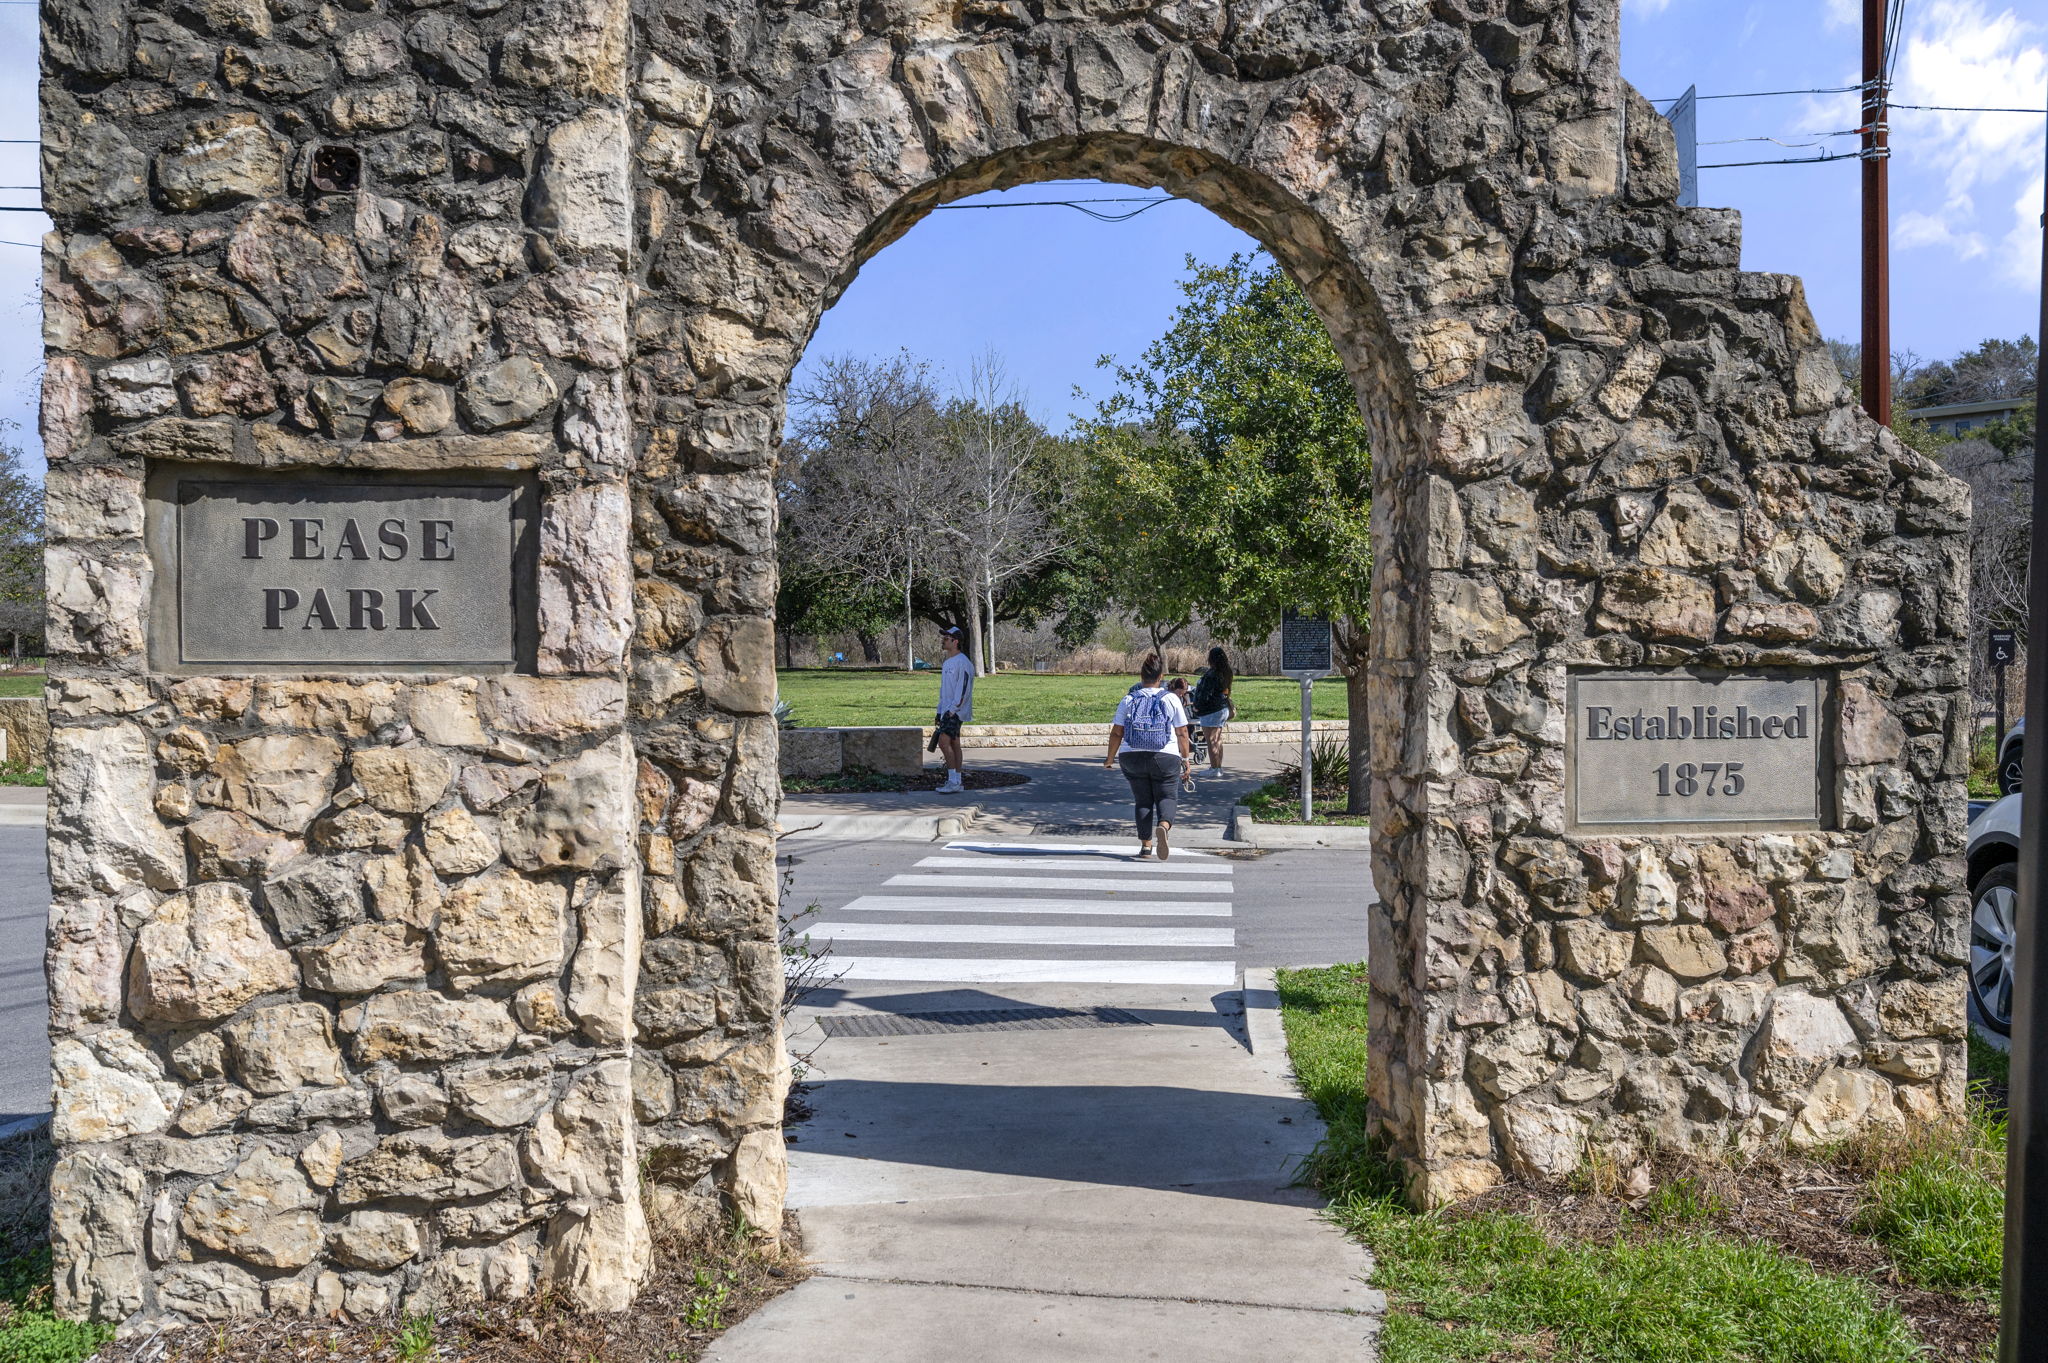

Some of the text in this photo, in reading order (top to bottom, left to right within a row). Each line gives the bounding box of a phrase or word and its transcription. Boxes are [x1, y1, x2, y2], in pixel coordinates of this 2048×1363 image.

[241, 517, 456, 562] PEASE
[262, 587, 441, 631] PARK
[1586, 704, 1809, 740] Established
[1652, 761, 1746, 797] 1875
